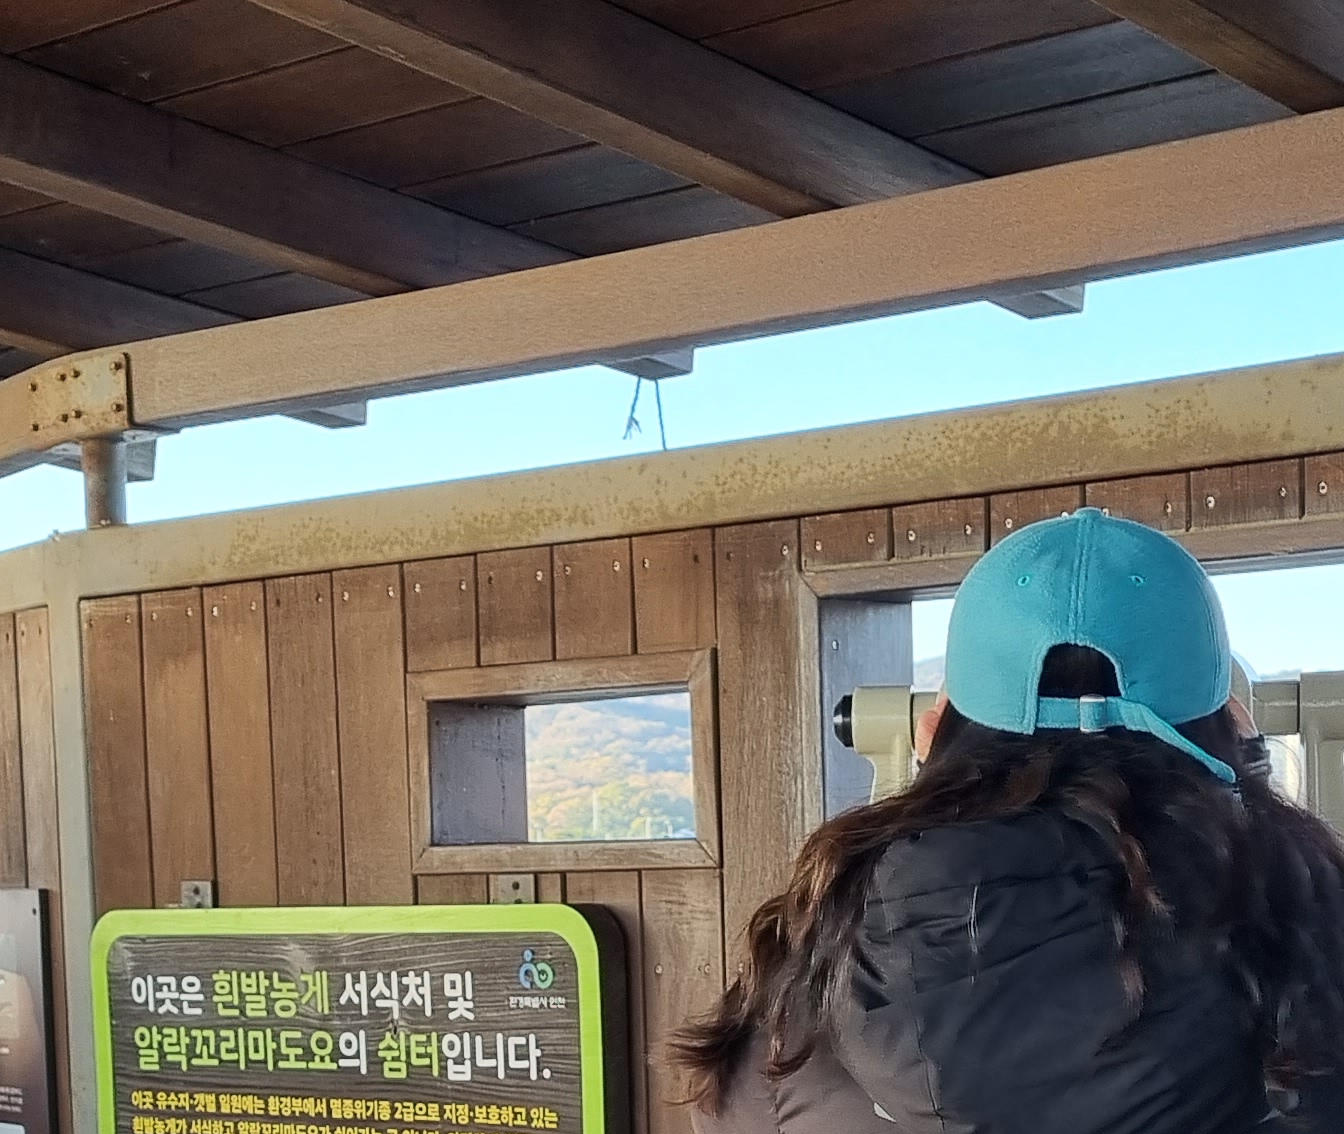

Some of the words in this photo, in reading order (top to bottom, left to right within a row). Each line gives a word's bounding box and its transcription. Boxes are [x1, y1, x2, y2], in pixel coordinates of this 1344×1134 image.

[131, 974, 205, 1015] 이곳은
[212, 969, 330, 1018] 흰발농게
[339, 970, 432, 1019] 서식처
[443, 970, 475, 1021] 및
[134, 1025, 368, 1075] 알락꼬리마도요의
[378, 1031, 552, 1081] 쉼터입니다.
[132, 1091, 155, 1108] 이곳
[155, 1091, 217, 1111] 유수지·갯벌
[218, 1094, 265, 1113] 일원에는
[267, 1096, 327, 1115] 환경부에서
[329, 1098, 391, 1120] 멸종위기종
[395, 1101, 440, 1121] 2급으로
[444, 1104, 527, 1125] 지정·보호하고
[529, 1107, 557, 1128] 있는
[133, 1116, 188, 1134] 흰발농게가
